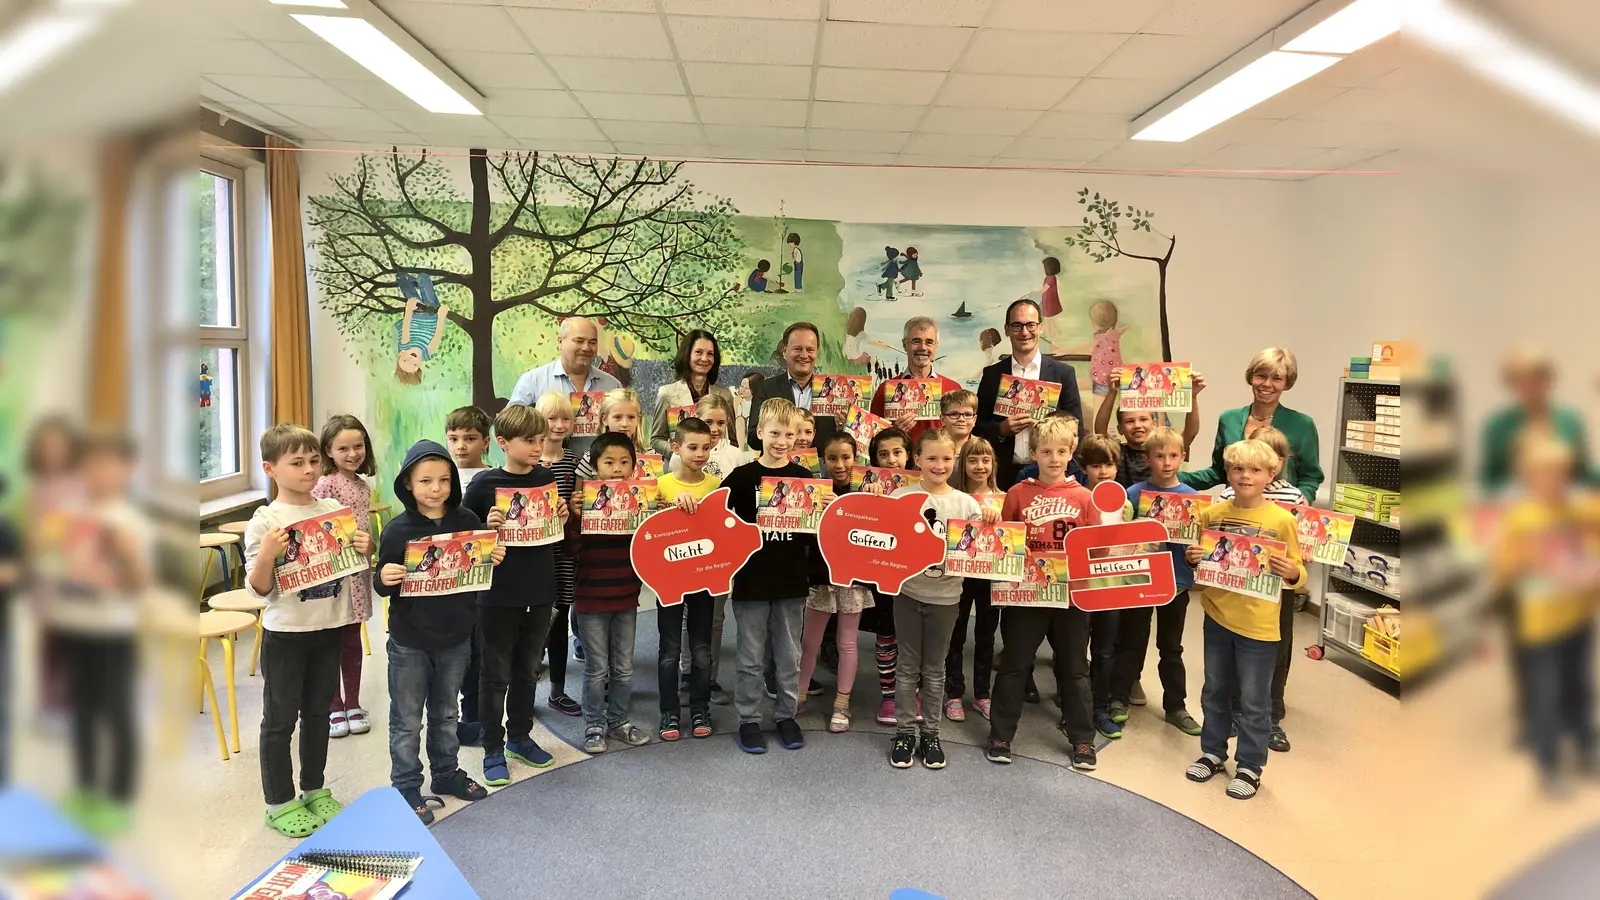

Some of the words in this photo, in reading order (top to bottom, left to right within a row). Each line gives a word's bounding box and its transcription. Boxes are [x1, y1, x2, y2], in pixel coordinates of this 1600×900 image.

[1031, 494, 1066, 506] Sports
[1022, 503, 1081, 523] Facility
[762, 531, 793, 541] TATE
[667, 543, 704, 561] Nicht
